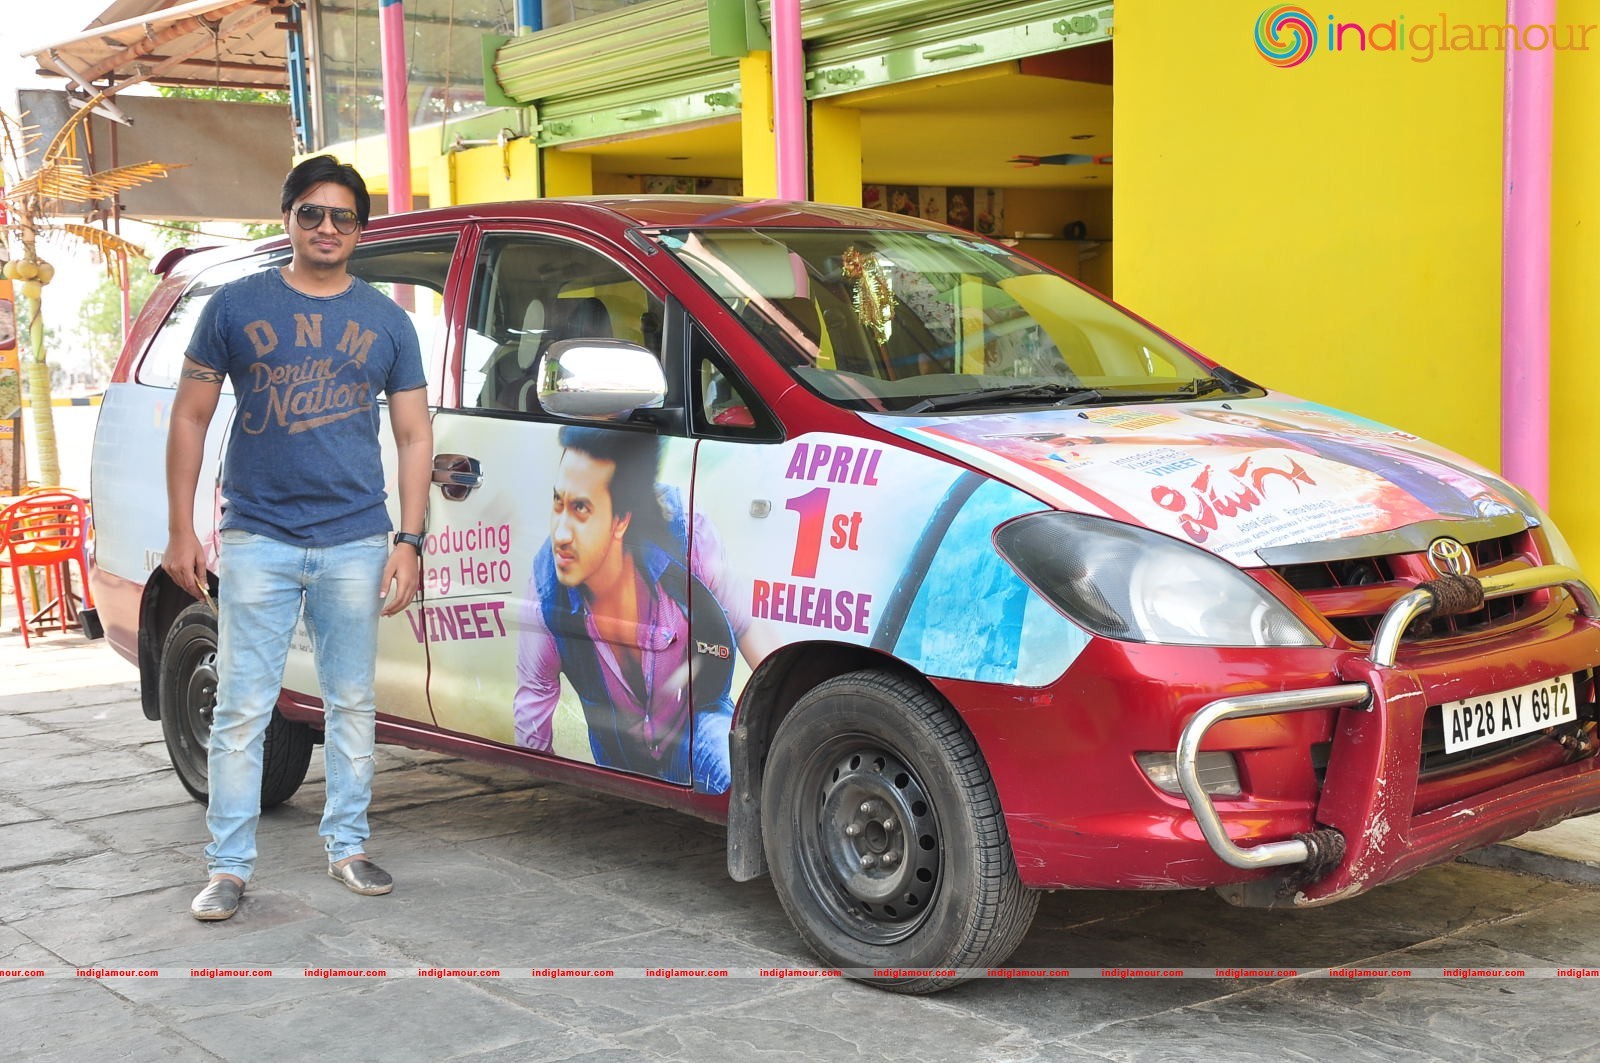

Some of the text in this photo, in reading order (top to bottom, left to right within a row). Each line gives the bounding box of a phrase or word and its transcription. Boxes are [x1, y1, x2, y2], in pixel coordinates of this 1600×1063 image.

[250, 356, 361, 393] Denim
[242, 378, 373, 435] Nation
[785, 442, 883, 487] APRIL
[1145, 457, 1203, 477] VINEET
[460, 556, 511, 586] Hero
[404, 601, 506, 644] VINEET
[751, 579, 873, 635] RELEASE
[1451, 682, 1571, 745] AP28 AY 6972
